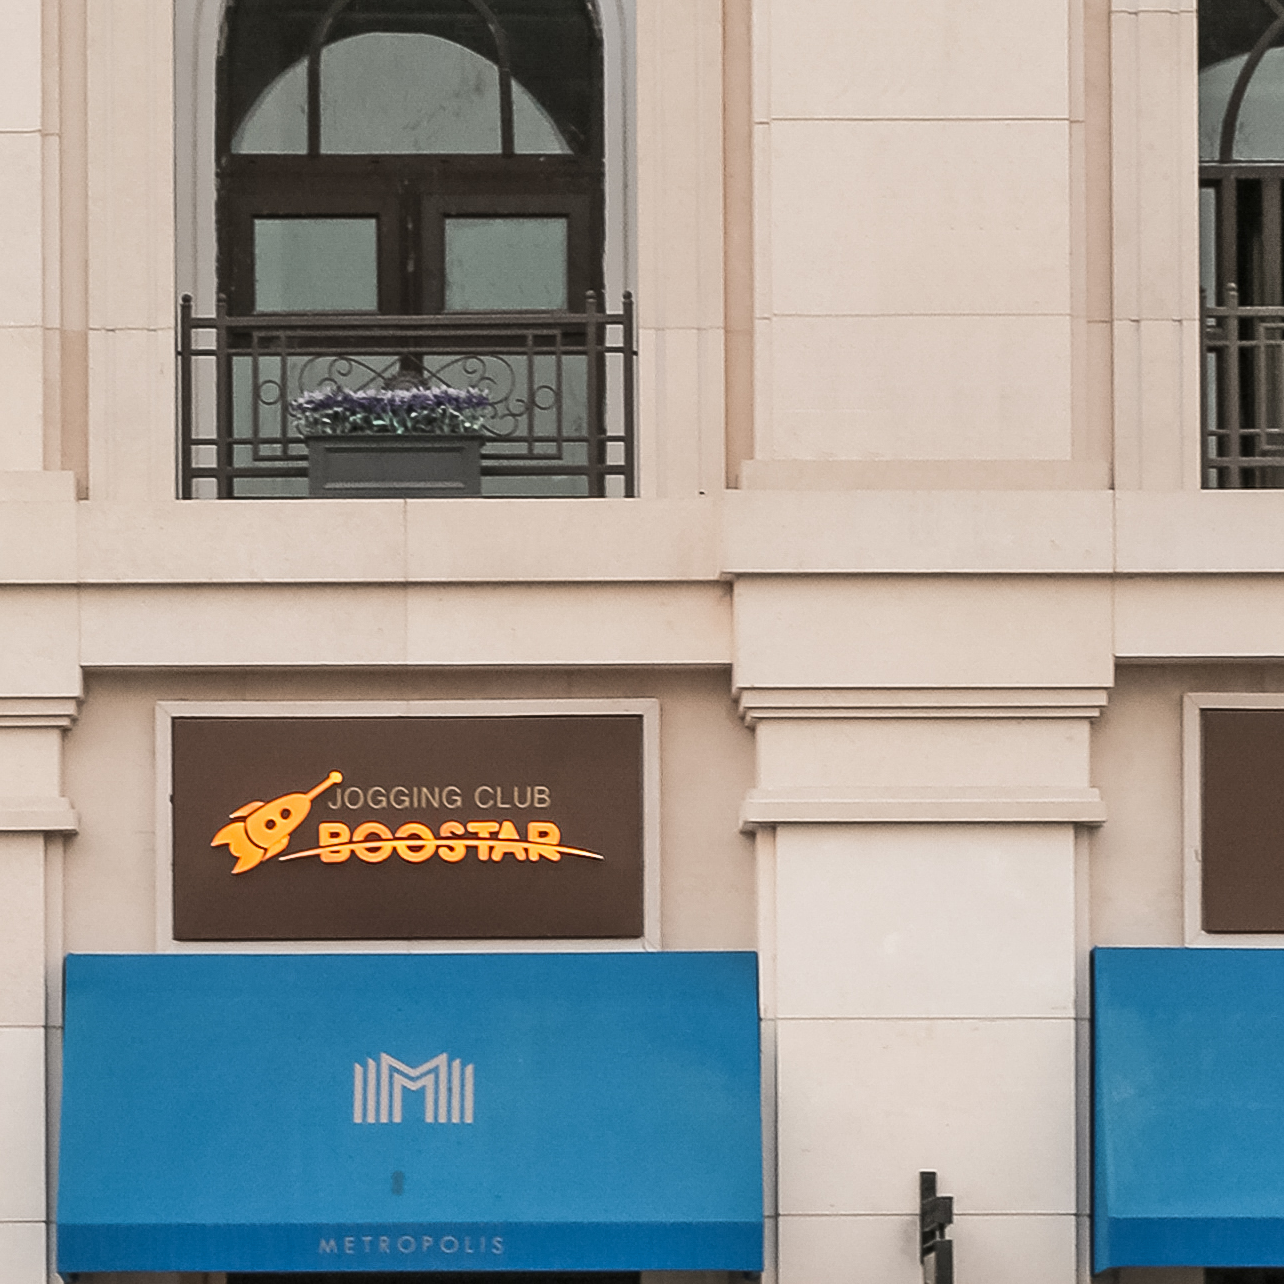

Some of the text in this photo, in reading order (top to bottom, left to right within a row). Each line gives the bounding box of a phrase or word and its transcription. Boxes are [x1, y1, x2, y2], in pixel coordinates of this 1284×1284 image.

[327, 785, 552, 810] JOGGING CLUB
[317, 820, 563, 864] BOOSTAR
[318, 1234, 505, 1255] METROPOLIS
